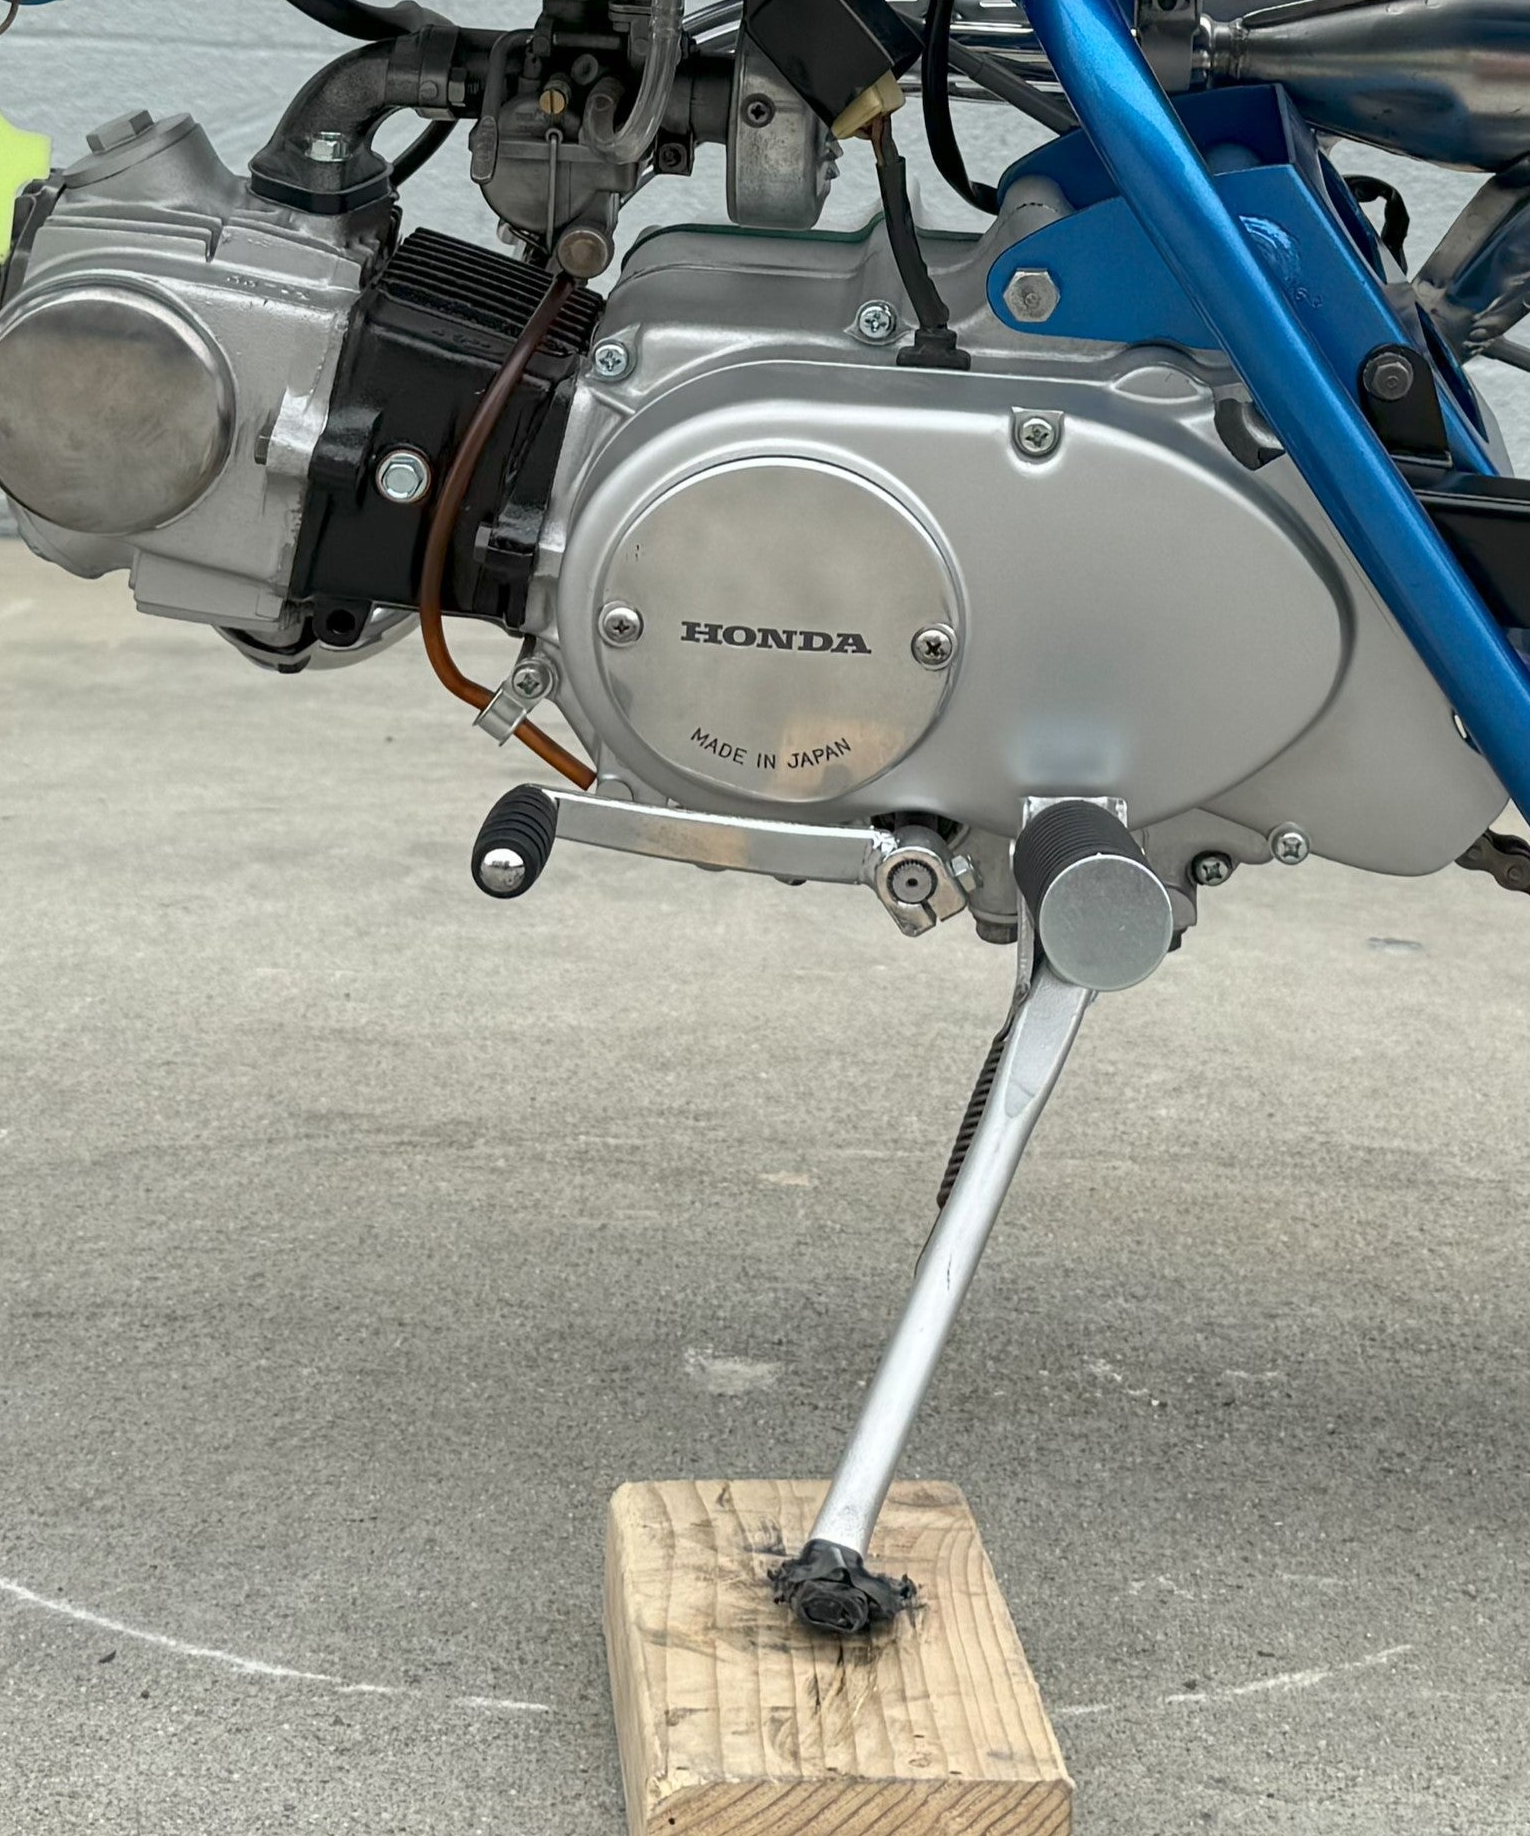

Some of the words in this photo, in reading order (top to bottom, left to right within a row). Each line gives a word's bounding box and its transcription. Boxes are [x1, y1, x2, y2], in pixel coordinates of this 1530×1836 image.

[681, 621, 871, 654] HONDA
[691, 727, 747, 764] MADE
[756, 751, 778, 770] IN
[786, 737, 852, 770] JAPAN
